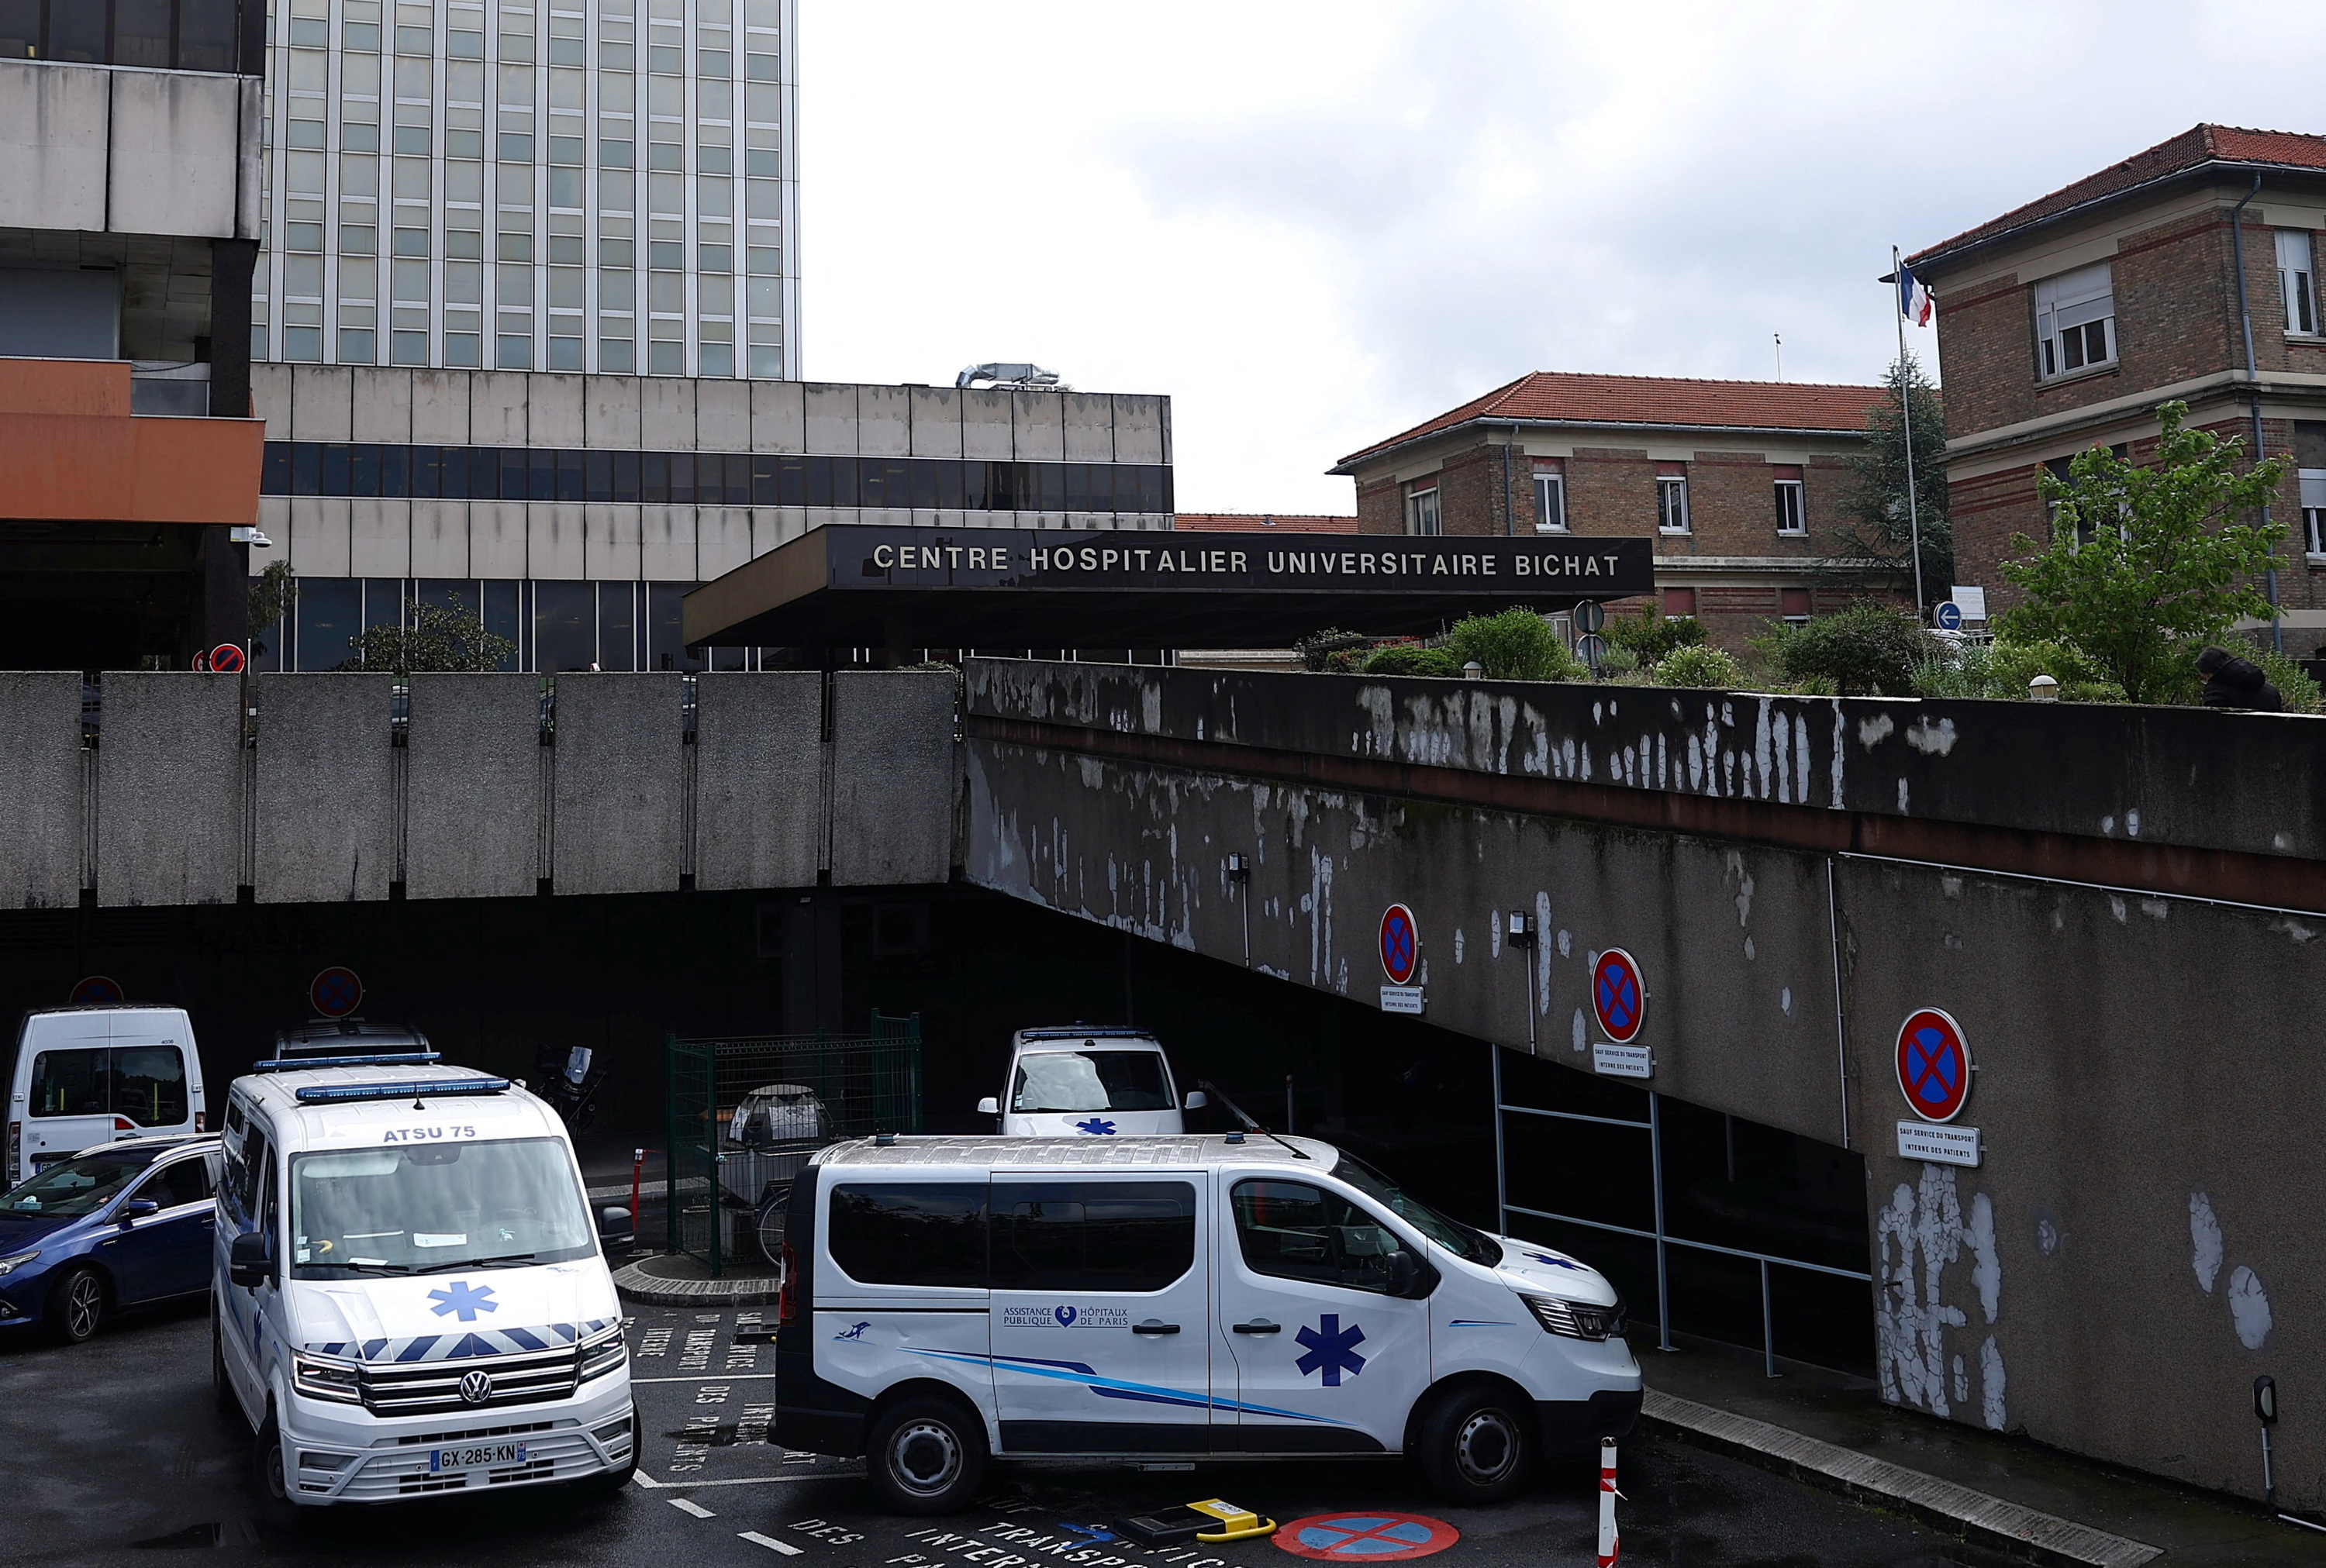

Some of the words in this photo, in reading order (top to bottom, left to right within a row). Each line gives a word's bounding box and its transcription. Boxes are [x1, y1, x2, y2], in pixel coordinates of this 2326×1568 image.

[874, 545, 1008, 570] CENTRE
[1030, 547, 1248, 573] HOSPITALIER
[1268, 551, 1496, 576] UNIVERSITAIRE
[1516, 554, 1619, 577] BICHAT
[383, 1127, 443, 1142] ATSU
[450, 1125, 476, 1138] 75
[1914, 1129, 1935, 1139] SERVICE
[1945, 1132, 1975, 1143] TRANSPORT
[1905, 1143, 1929, 1153] INTERNE
[1944, 1148, 1970, 1158] PATIENTS
[736, 1311, 762, 1326] SAU
[1003, 1308, 1051, 1316] ASSISTANCE
[1080, 1306, 1127, 1316] HÔPITAUX
[1003, 1316, 1051, 1325] PUBLIQUE
[636, 1328, 674, 1357] INTERNE
[677, 1328, 716, 1370] TRANSPORT
[695, 1386, 730, 1404] DES
[441, 1445, 515, 1466] GX-285-KN
[787, 1518, 865, 1545] DES
